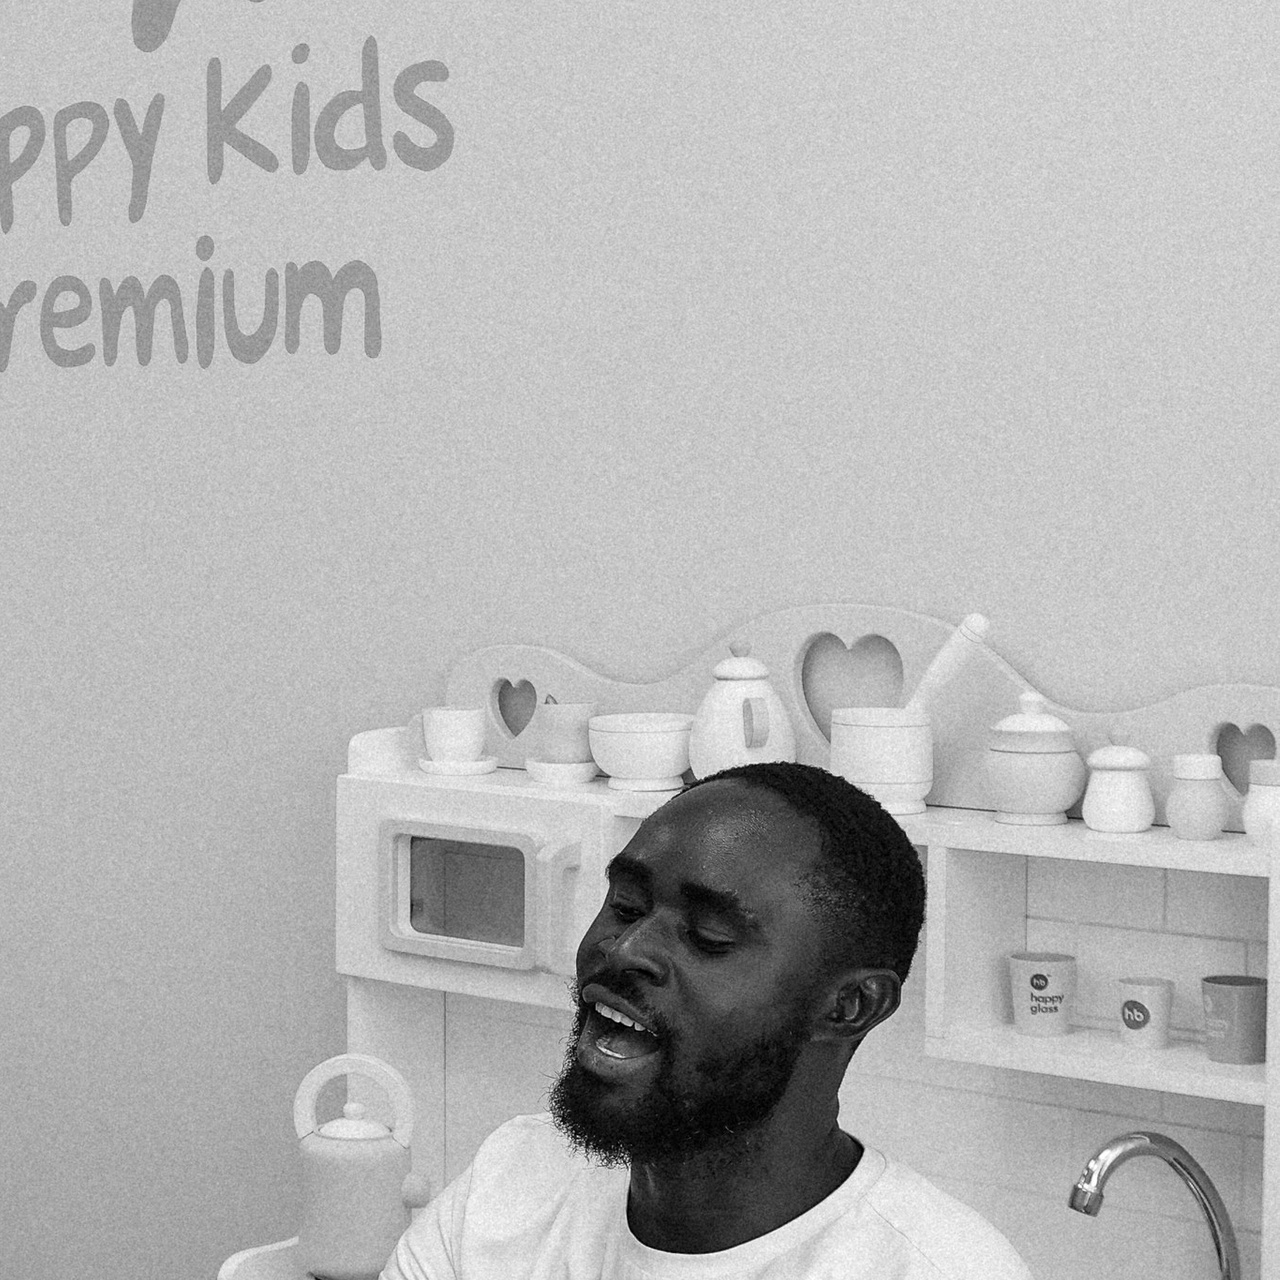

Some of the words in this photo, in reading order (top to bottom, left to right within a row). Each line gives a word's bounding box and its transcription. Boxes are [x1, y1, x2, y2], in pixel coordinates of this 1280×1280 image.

[206, 35, 455, 185] Kids
[1030, 992, 1065, 1005] happy
[1030, 1004, 1059, 1016] glass
[1124, 1007, 1144, 1022] hb
